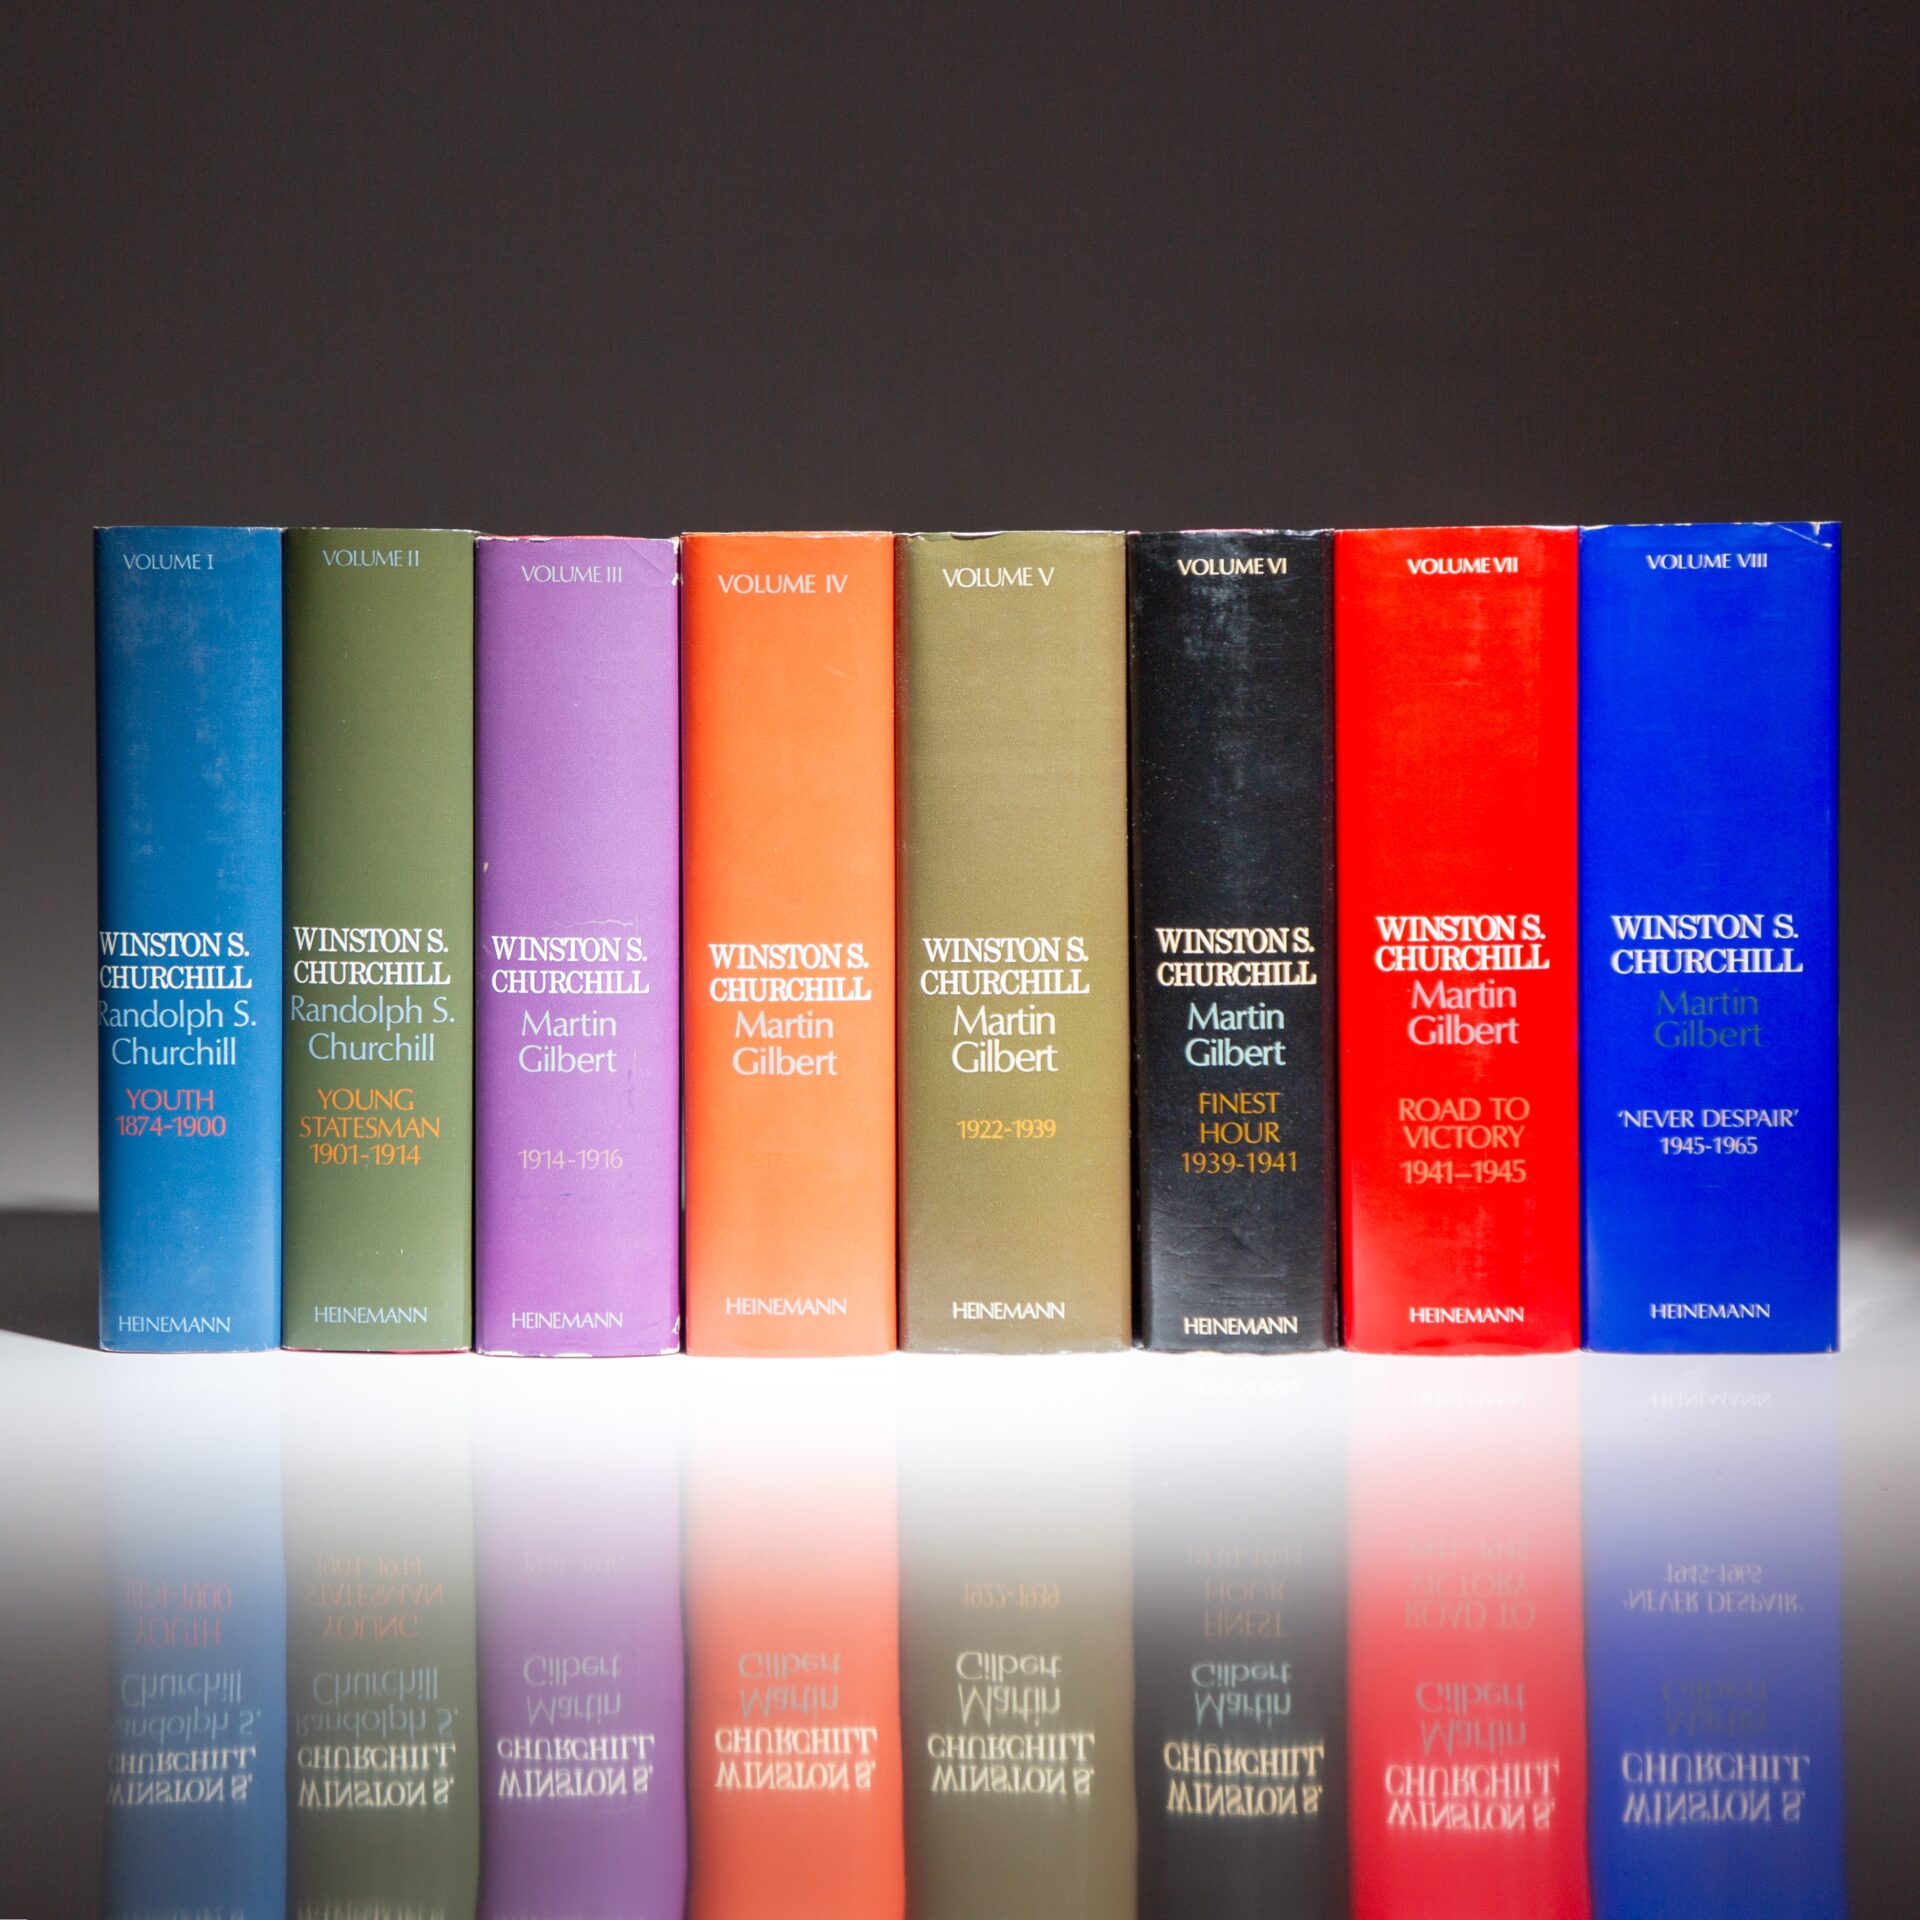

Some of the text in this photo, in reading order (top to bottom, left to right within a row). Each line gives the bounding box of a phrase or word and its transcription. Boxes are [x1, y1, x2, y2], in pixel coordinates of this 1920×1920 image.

[123, 554, 214, 570] VOLUME I
[322, 550, 419, 567] VOLUME II
[1177, 558, 1287, 576] VOLUME VI
[1407, 557, 1518, 575] VOLUME VII
[1646, 553, 1767, 570] VOLUME VIII
[522, 566, 622, 583] VOLUME III
[718, 574, 848, 594] VOLUME IV
[942, 566, 1055, 588] VOLUME V
[1375, 915, 1546, 942] WINSTON S.
[1611, 914, 1799, 939] WINSTON S.
[99, 932, 250, 958] WINSTON S.
[293, 927, 449, 953] WINSTON S.
[492, 936, 648, 962] WINSTON S.
[922, 936, 1089, 964] WINSTON S.
[1156, 928, 1315, 954] WINSTON S.
[709, 944, 869, 970] WINSTON S.
[1375, 945, 1550, 971] CHURCHILL
[1610, 949, 1803, 975] CHURCHILL
[100, 965, 252, 989] CHURCHILL
[294, 960, 451, 985] CHURCHILL
[492, 970, 650, 994] CHURCHILL
[920, 970, 1090, 996] CHURCHILL
[1156, 960, 1317, 988] CHURCHILL
[710, 976, 872, 1002] CHURCHILL
[1410, 980, 1517, 1011] Martin
[291, 995, 455, 1030] Randolph S.
[1656, 989, 1758, 1016] Martin
[99, 999, 257, 1035] Randolph S.
[522, 1010, 616, 1037] Martin
[734, 1010, 834, 1039] Martin
[952, 1004, 1055, 1036] Martin
[1187, 1002, 1284, 1030] Martin
[1407, 1014, 1519, 1045] Gilbert
[1654, 1020, 1762, 1048] Gilbert
[111, 1037, 236, 1066] Churchill
[308, 1032, 434, 1061] Churchill
[518, 1044, 617, 1073] Gilbert
[952, 1040, 1058, 1074] Gilbert
[1184, 1037, 1286, 1068] Gilbert
[732, 1046, 838, 1076] Gilbert
[125, 1088, 214, 1110] YOUTH
[317, 1088, 414, 1110] YOUNG
[1198, 1092, 1280, 1114] FINEST
[1398, 1097, 1530, 1122] ROAD TO
[116, 1116, 226, 1137] 1874-1900
[300, 1116, 440, 1138] STATESMAN
[957, 1119, 1056, 1140] 1922-1939
[1200, 1122, 1280, 1144] HOUR
[1403, 1125, 1525, 1149] VICTORY
[310, 1144, 420, 1166] 1901-1914
[1660, 1136, 1758, 1155] 1945-1965
[518, 1149, 623, 1170] 1914-1916
[1182, 1150, 1298, 1174] 1939-1941
[314, 1306, 428, 1323] HEINEMANN
[726, 1298, 847, 1316] HEINEMANN
[952, 1302, 1065, 1320] HEINEMANN
[1409, 1306, 1524, 1324] HEINEMANN
[1651, 1303, 1770, 1320] HEINEMANN
[119, 1315, 231, 1333] HEINEMANN
[512, 1312, 623, 1329] HEINEMANN
[1184, 1316, 1298, 1334] HEINEMANN
